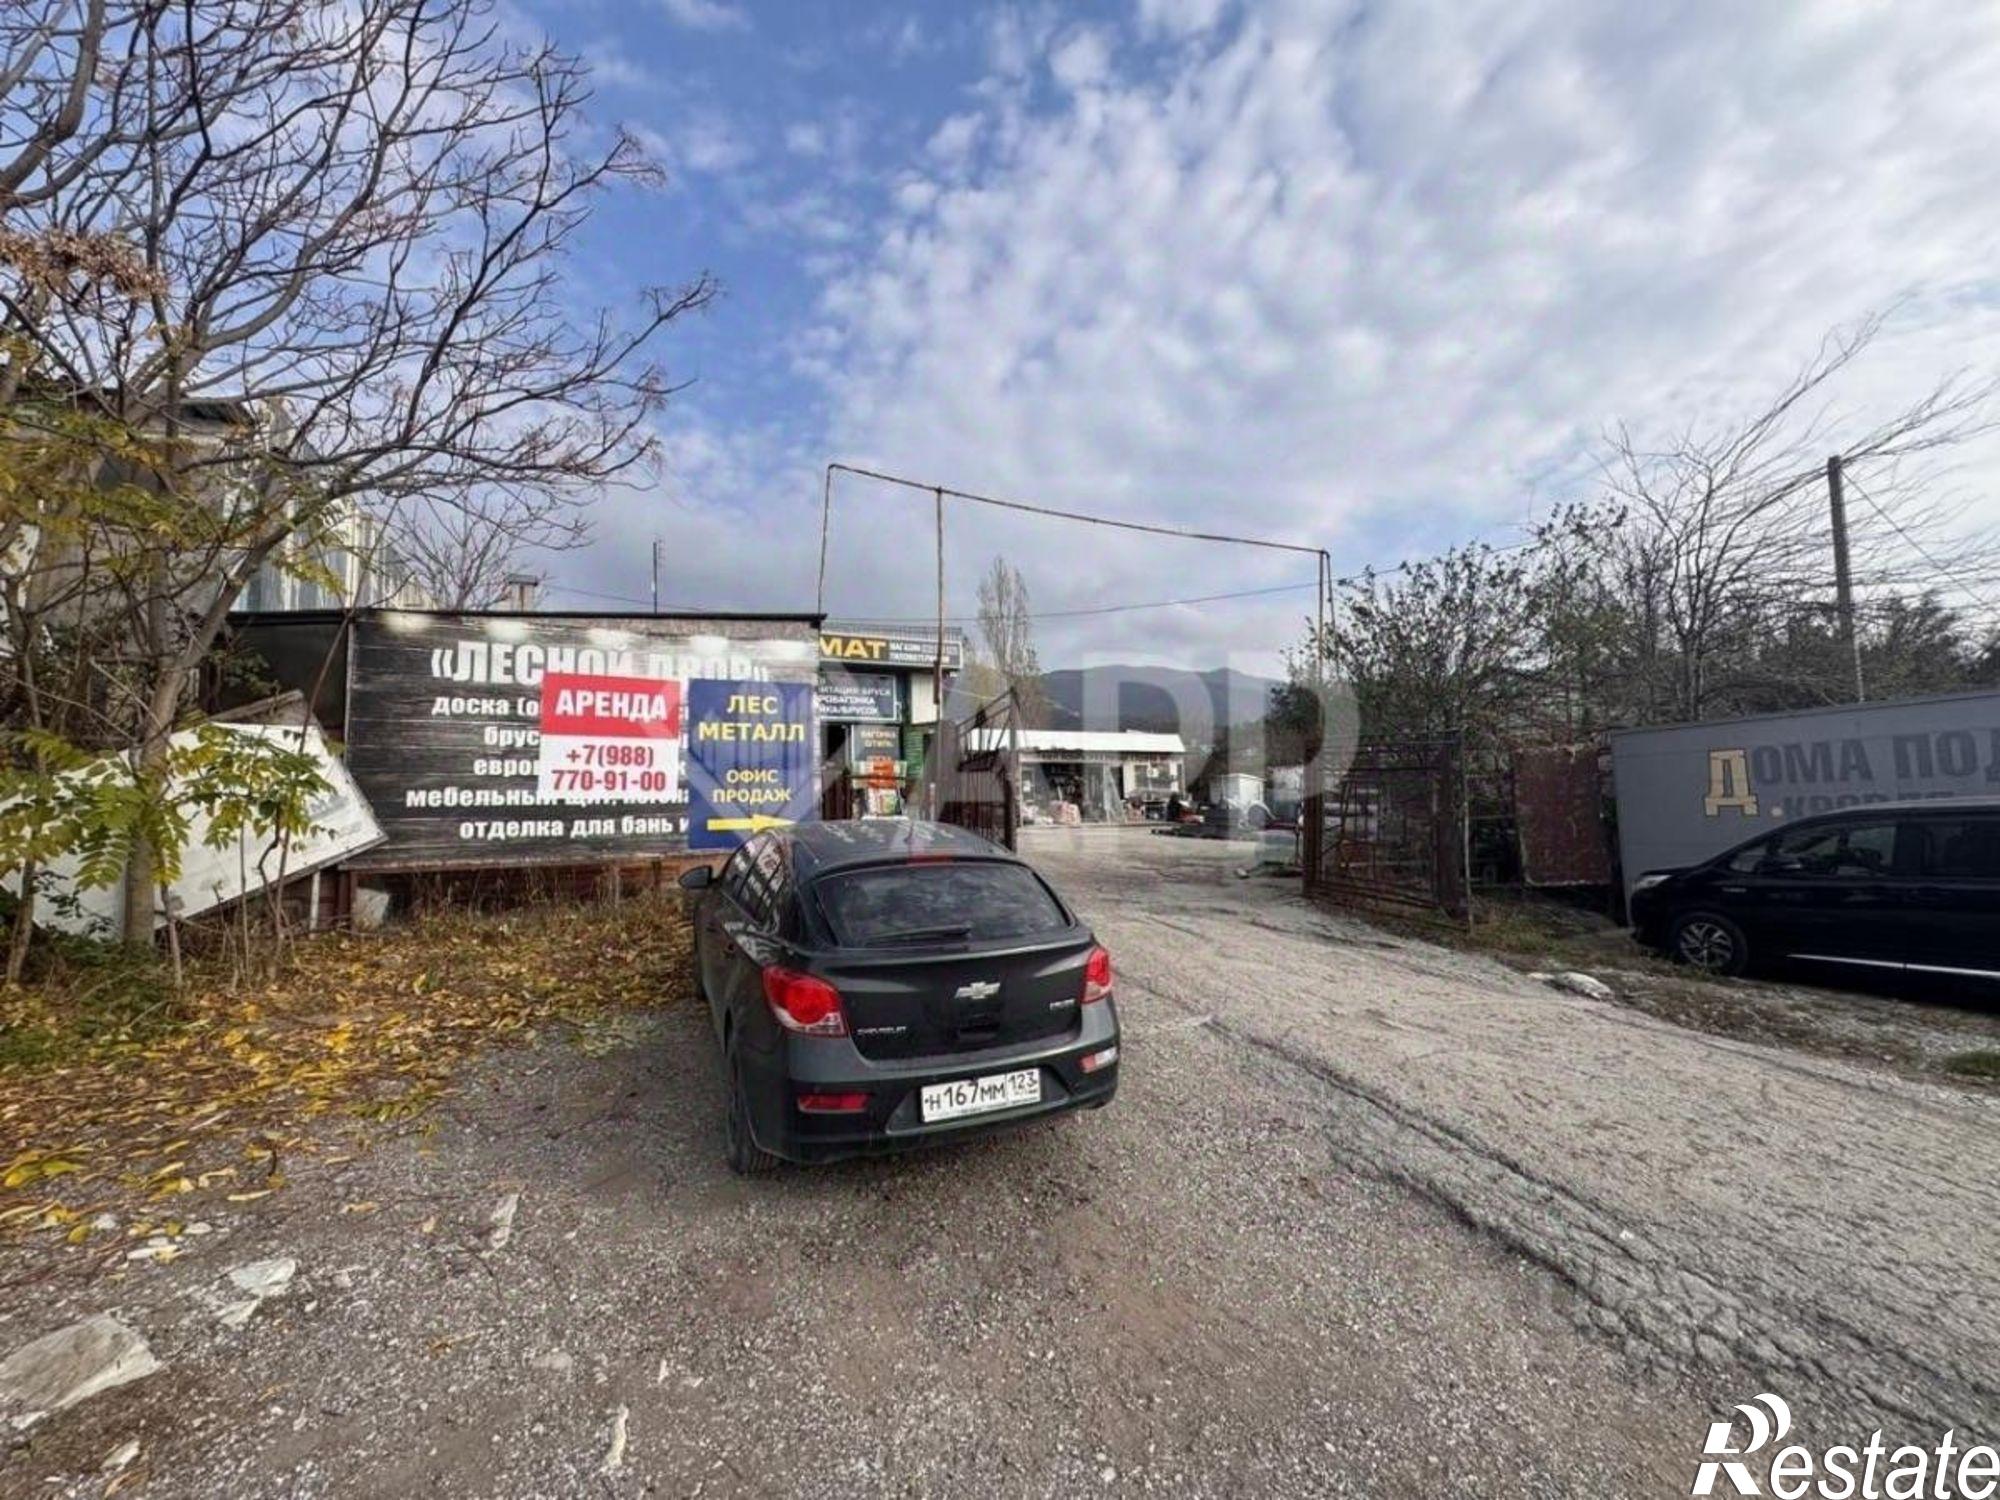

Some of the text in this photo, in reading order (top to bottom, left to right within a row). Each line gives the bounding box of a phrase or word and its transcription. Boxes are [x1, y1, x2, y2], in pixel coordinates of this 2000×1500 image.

[431, 696, 510, 716] доска
[555, 689, 668, 722] АРЕНДА
[727, 695, 778, 714] ЛЕС
[484, 726, 540, 748] брус
[699, 722, 805, 742] МЕТАЛЛ
[566, 745, 655, 767] +7(988)
[551, 769, 666, 792] 770-91-00
[726, 769, 778, 784] ОФИС
[1705, 738, 1873, 816] ДОМА
[712, 788, 792, 803] ПРОДАЖ
[460, 819, 564, 840] отделка
[570, 819, 615, 838] для
[621, 815, 673, 834] бань
[1008, 1071, 1037, 1090] 123
